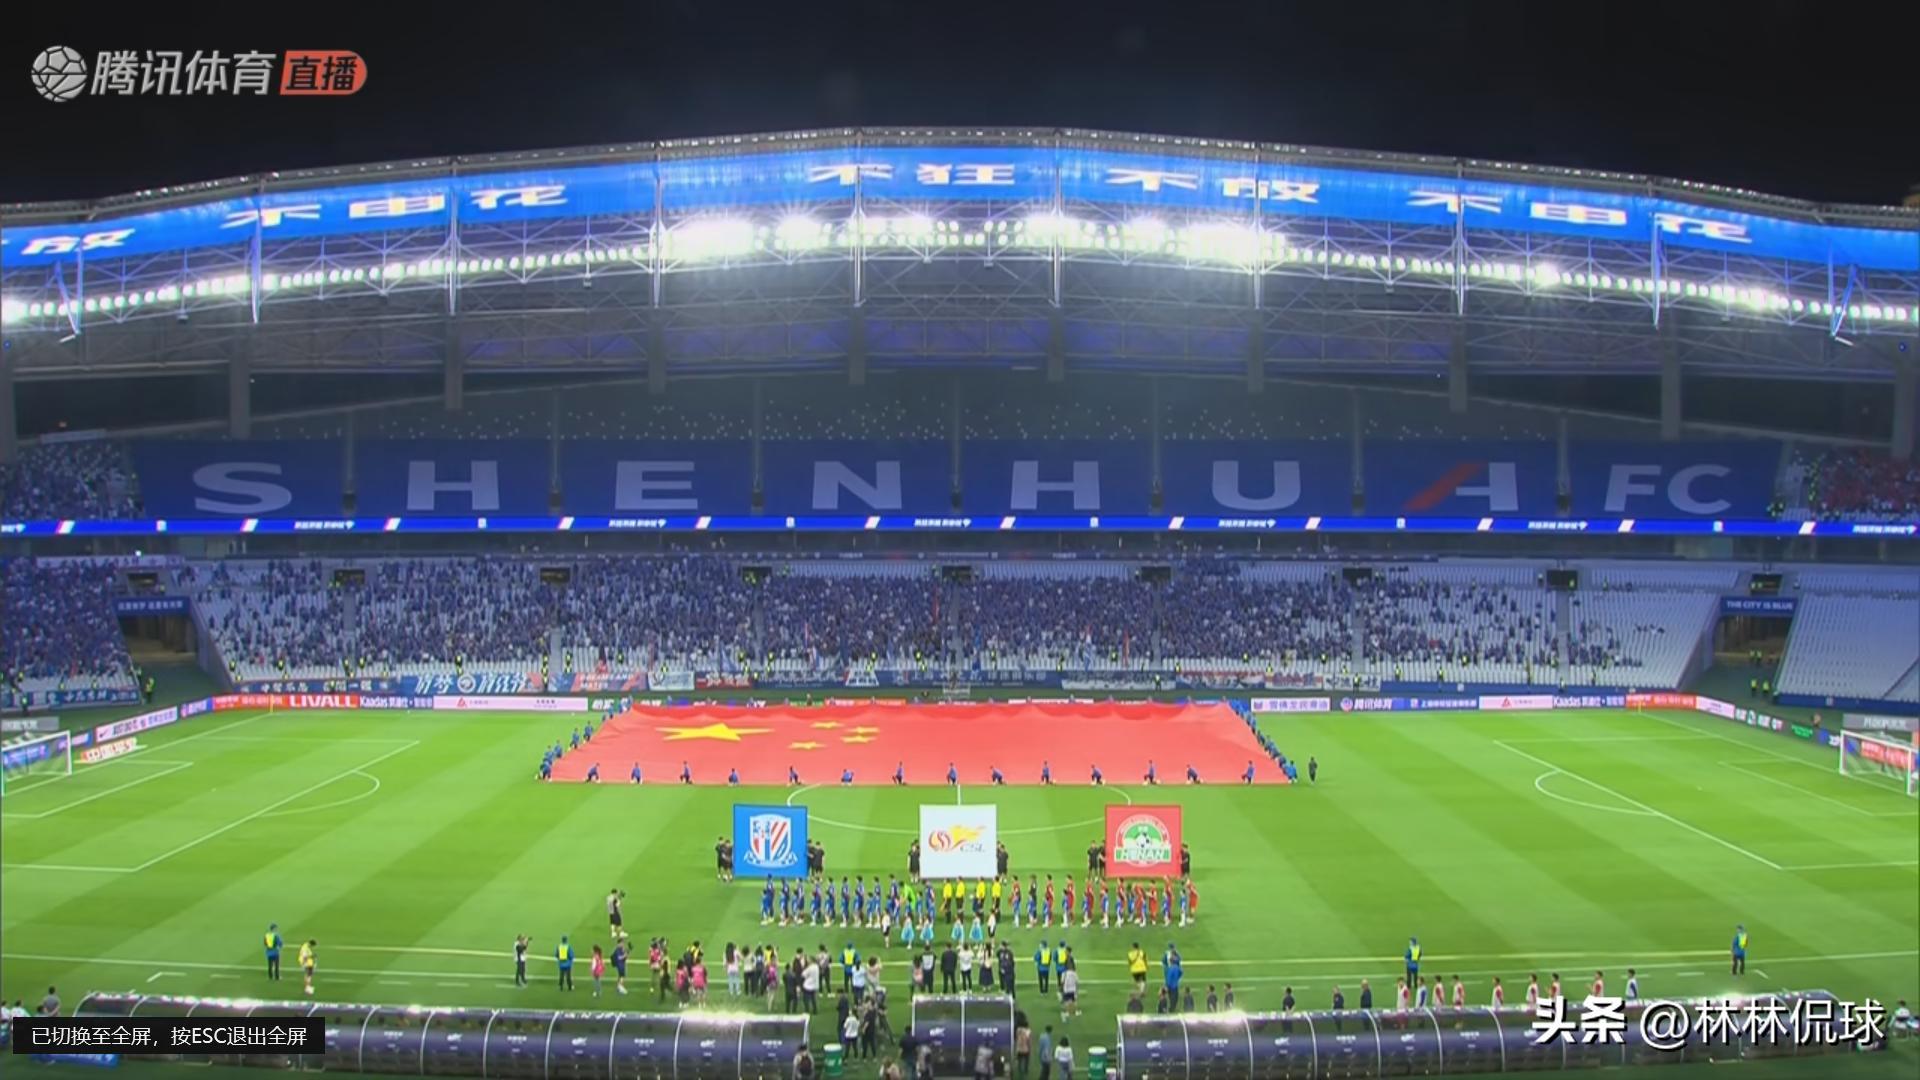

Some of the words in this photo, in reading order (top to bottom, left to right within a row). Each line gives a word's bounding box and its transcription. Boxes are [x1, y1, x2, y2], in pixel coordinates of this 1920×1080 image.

[1604, 463, 1733, 514] FC
[1726, 600, 1741, 609] THE
[1743, 600, 1761, 609] CITY
[1772, 600, 1793, 611] BLUE
[290, 694, 358, 708] LIVALL
[1119, 848, 1164, 861] HNAN
